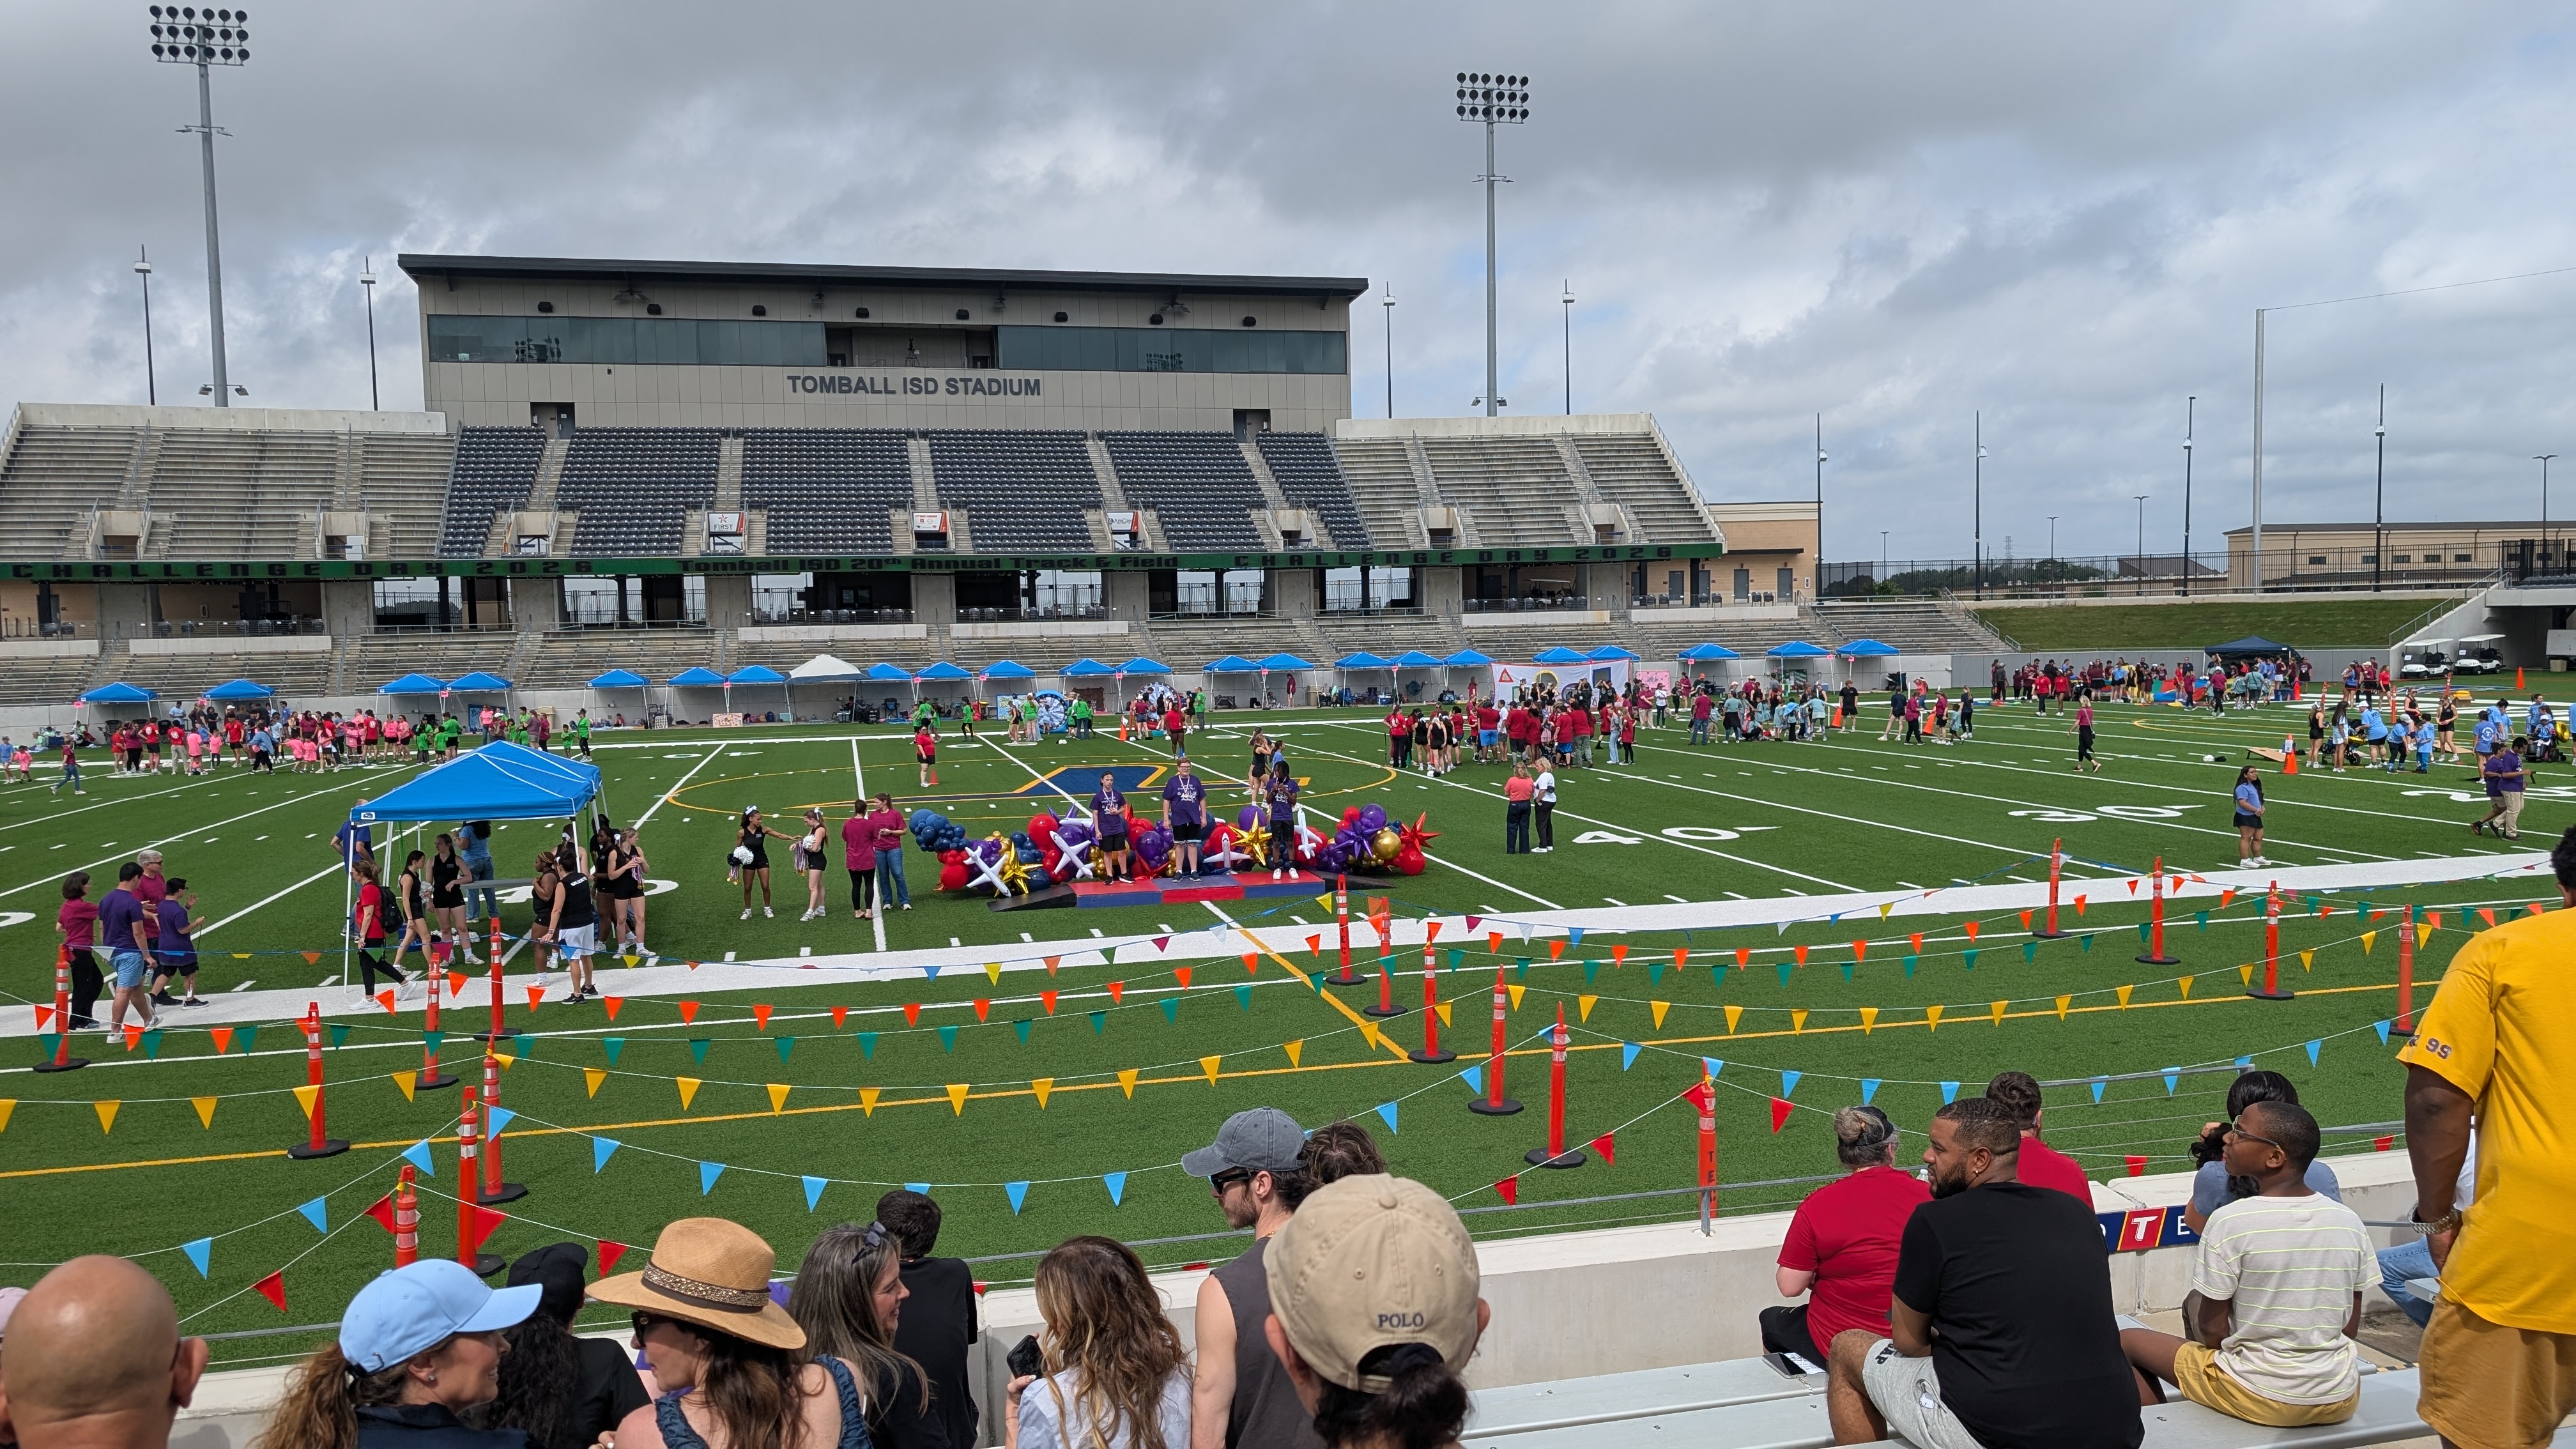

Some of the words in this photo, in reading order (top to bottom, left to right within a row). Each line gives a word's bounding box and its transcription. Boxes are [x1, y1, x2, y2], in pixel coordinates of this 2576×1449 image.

[787, 375, 896, 394] TOMBALL
[903, 377, 939, 395] ISD
[946, 378, 1041, 396] STADIUM
[677, 559, 789, 572] Tomball
[799, 558, 840, 571] ISD
[850, 557, 902, 571] 20th
[911, 556, 1000, 570] Annual
[1009, 556, 1087, 569] Track
[1094, 556, 1112, 569] &
[1119, 555, 1178, 568] Field
[1478, 549, 1548, 562] DAY
[355, 562, 443, 575] DAY
[1377, 1312, 1425, 1329] POLO
